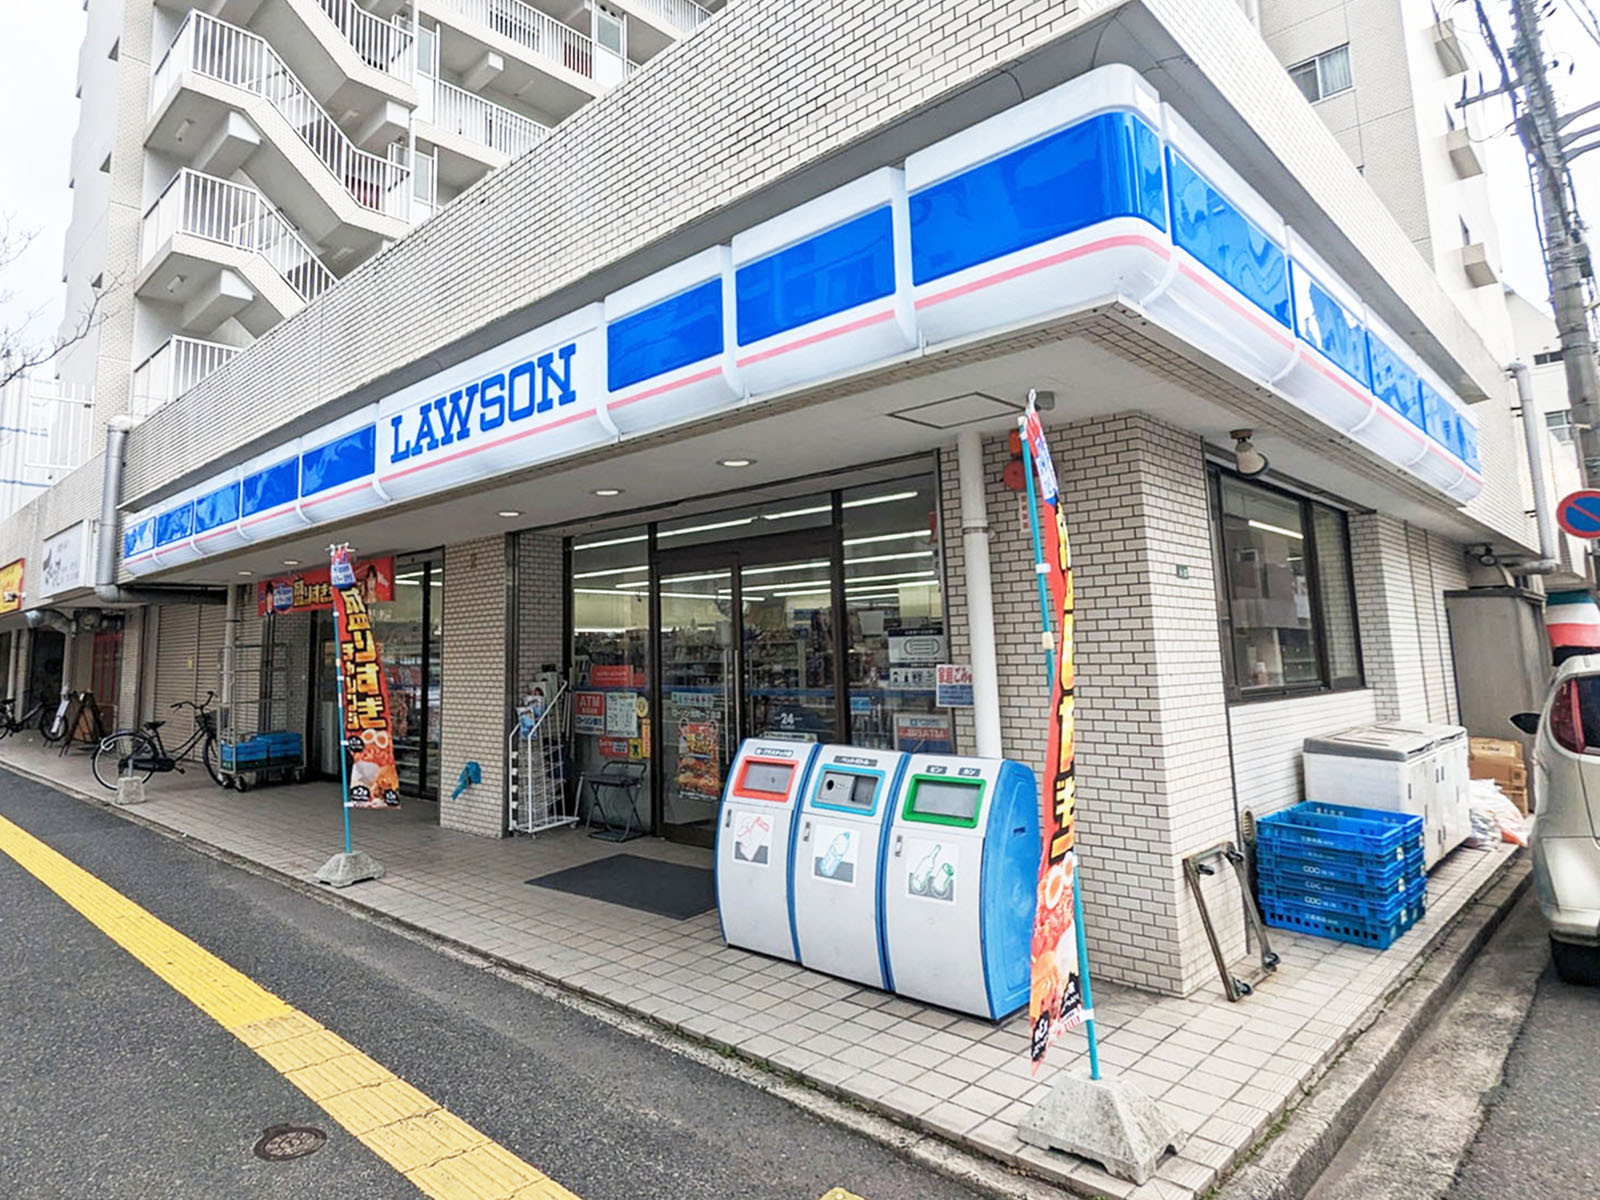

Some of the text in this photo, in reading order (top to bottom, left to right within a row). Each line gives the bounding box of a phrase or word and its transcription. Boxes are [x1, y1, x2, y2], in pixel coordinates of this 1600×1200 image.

[391, 343, 576, 464] LAWSON
[341, 587, 387, 729] 盛りすぎ
[580, 696, 600, 707] ATM
[780, 713, 795, 724] 24
